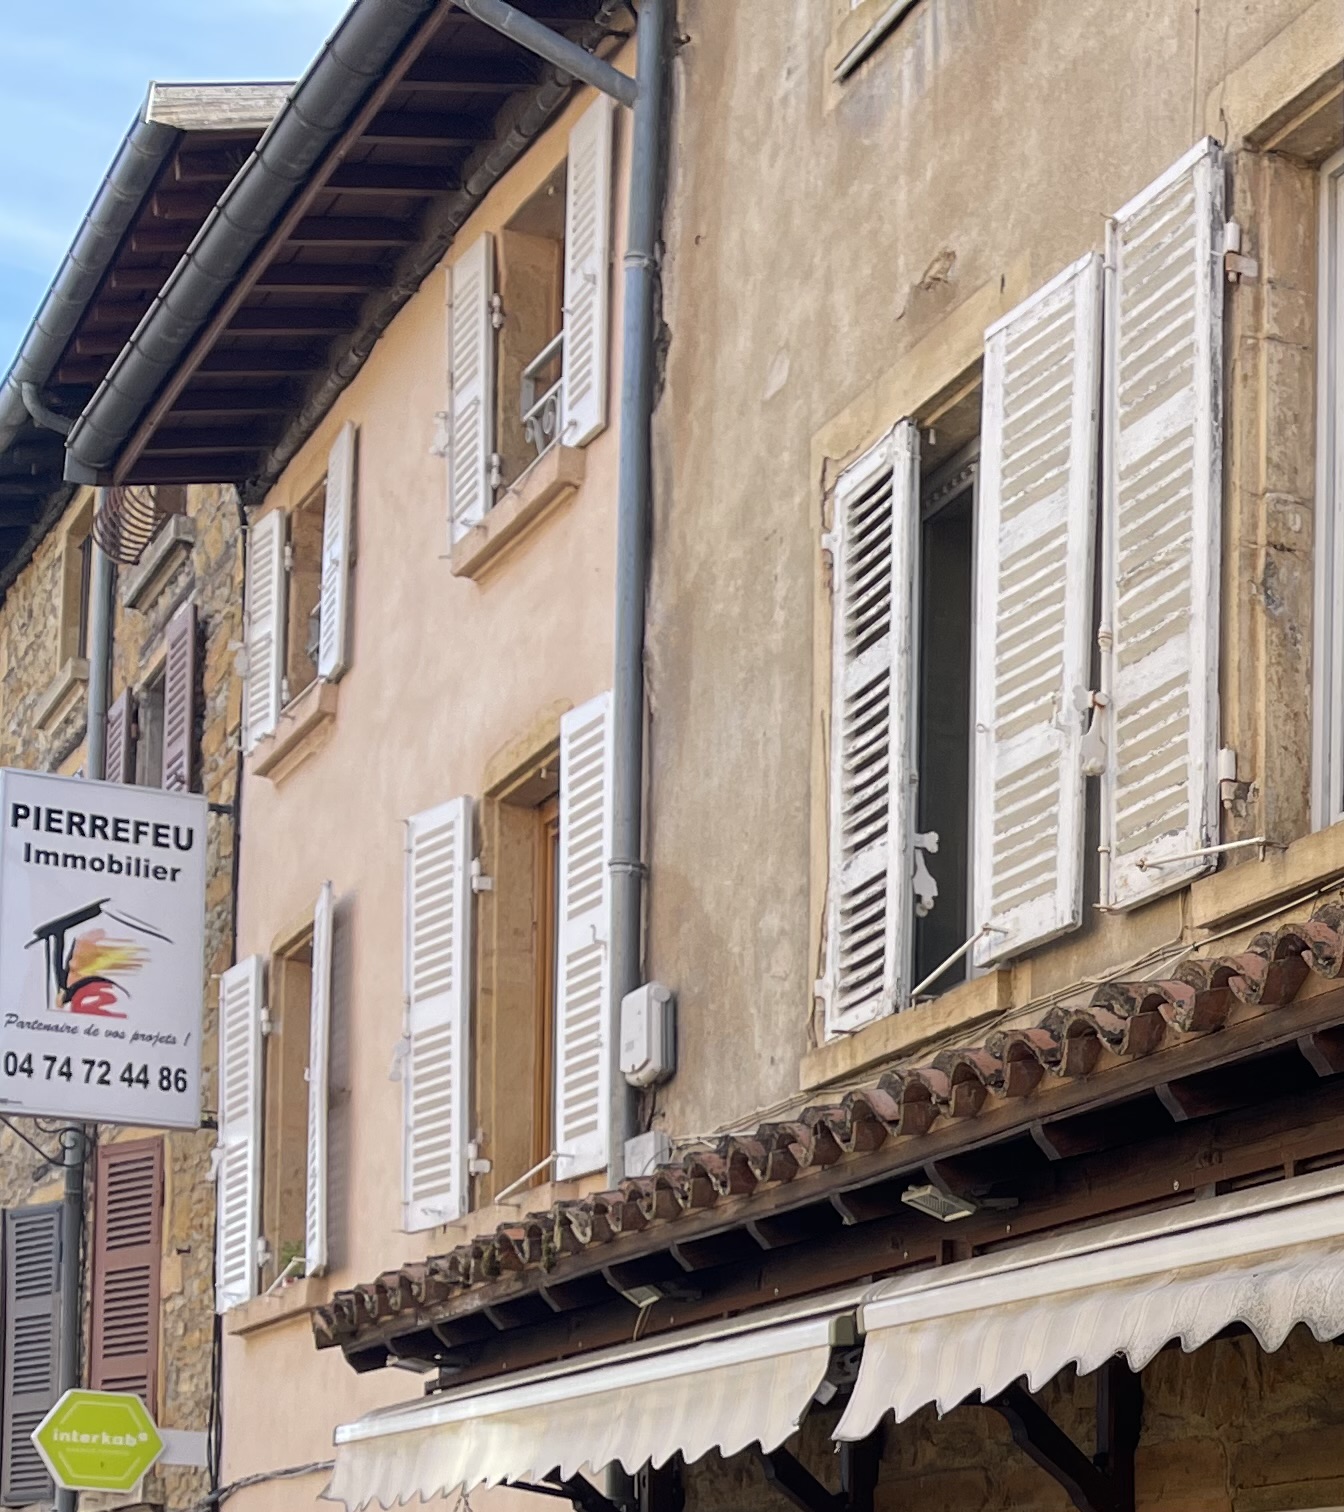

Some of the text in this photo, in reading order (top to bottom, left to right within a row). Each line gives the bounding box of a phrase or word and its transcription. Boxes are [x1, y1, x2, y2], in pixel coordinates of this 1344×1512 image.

[10, 802, 194, 851] PIERREFEU
[23, 842, 182, 883] Immobilier
[4, 1012, 79, 1035] Partenaire
[83, 1023, 100, 1037] de
[104, 1028, 126, 1040] vos
[129, 1030, 177, 1047] projets
[3, 1051, 188, 1093] 04 74 72 44 86
